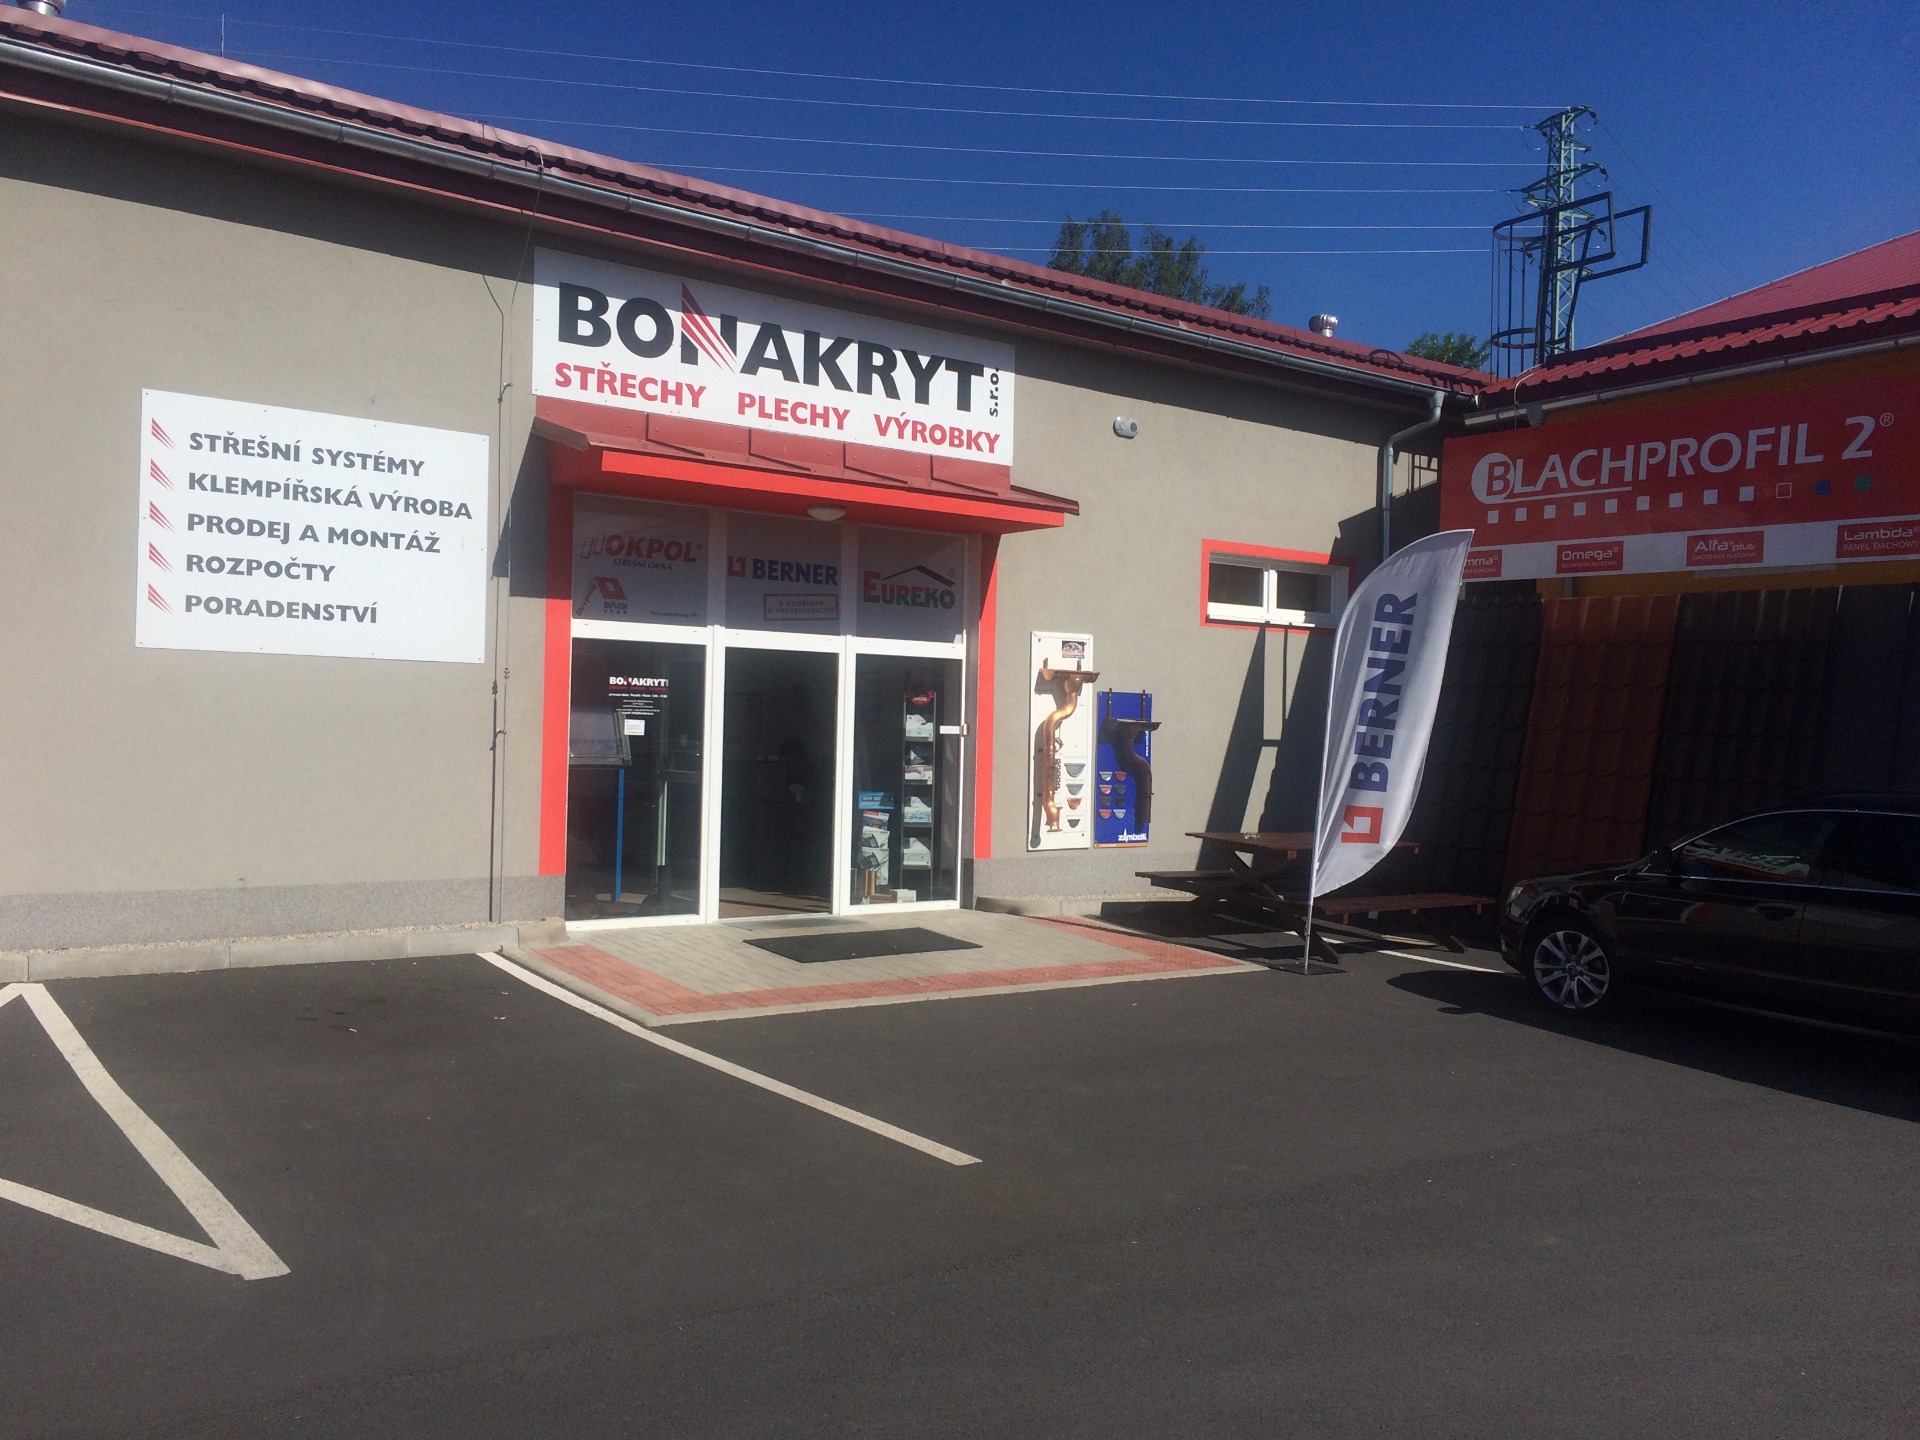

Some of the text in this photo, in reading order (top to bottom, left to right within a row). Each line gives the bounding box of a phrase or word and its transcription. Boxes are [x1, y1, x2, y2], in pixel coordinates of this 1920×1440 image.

[558, 280, 984, 413] BONAKRYT
[554, 361, 1001, 454] STŘECHY PLECHY VÝROBKY
[989, 367, 999, 417] s.r.o.
[189, 431, 425, 477] STŘEŠNÍ SYSTÉMY
[1471, 423, 1824, 504] BLACHPROFIL
[188, 472, 473, 520] KLEMPÍŘSKÁ VÝROBA
[187, 513, 441, 553] PRODEJ A MONTÁŽ
[605, 534, 697, 563] OKPOL
[1694, 539, 1756, 552] Alfa plus
[1843, 543, 1871, 551] PANEL
[1844, 527, 1913, 541] Lambda
[186, 554, 336, 582] ROZPOČTY
[752, 558, 839, 586] BERNER
[1561, 549, 1613, 562] Omega
[863, 570, 956, 610] EUREKO
[185, 594, 378, 624] PORADENSTVÍ
[609, 675, 666, 686] BONAKRYT
[1349, 592, 1418, 792] BERNER
